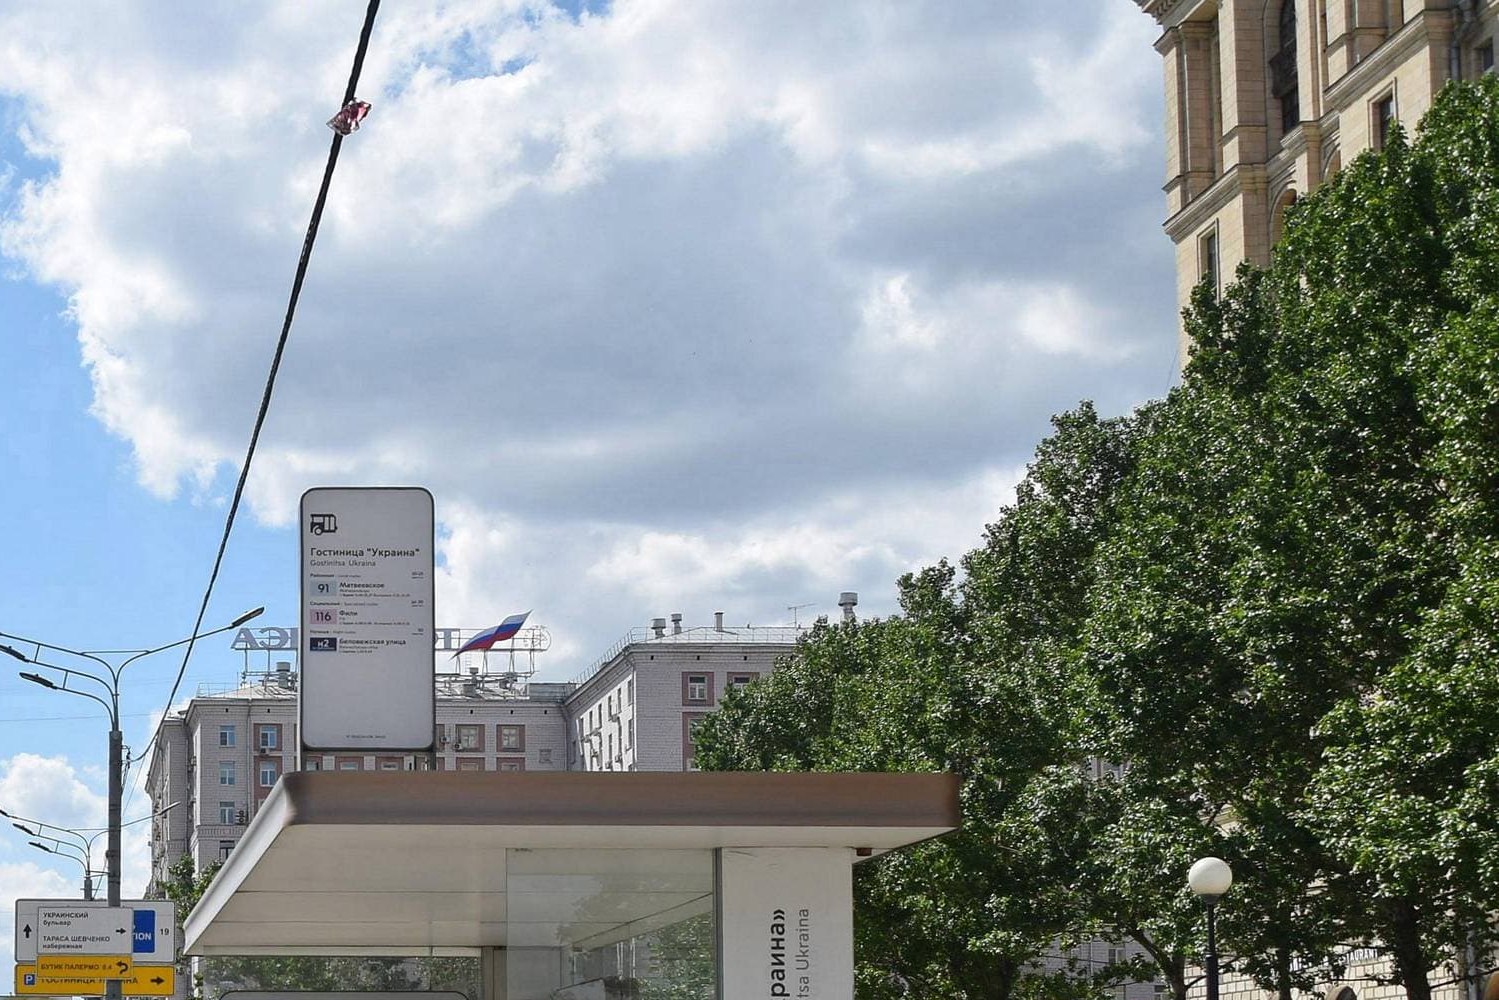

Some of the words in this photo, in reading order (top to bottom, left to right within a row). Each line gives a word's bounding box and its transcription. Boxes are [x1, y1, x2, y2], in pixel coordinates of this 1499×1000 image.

[310, 548, 364, 558] Гостиница
[367, 548, 420, 558] "Украина"
[317, 584, 329, 593] 91
[316, 612, 332, 621] 116
[43, 911, 89, 919] УКРАИНСКИЙ
[133, 932, 152, 940] ION
[796, 908, 810, 970] Ukraina
